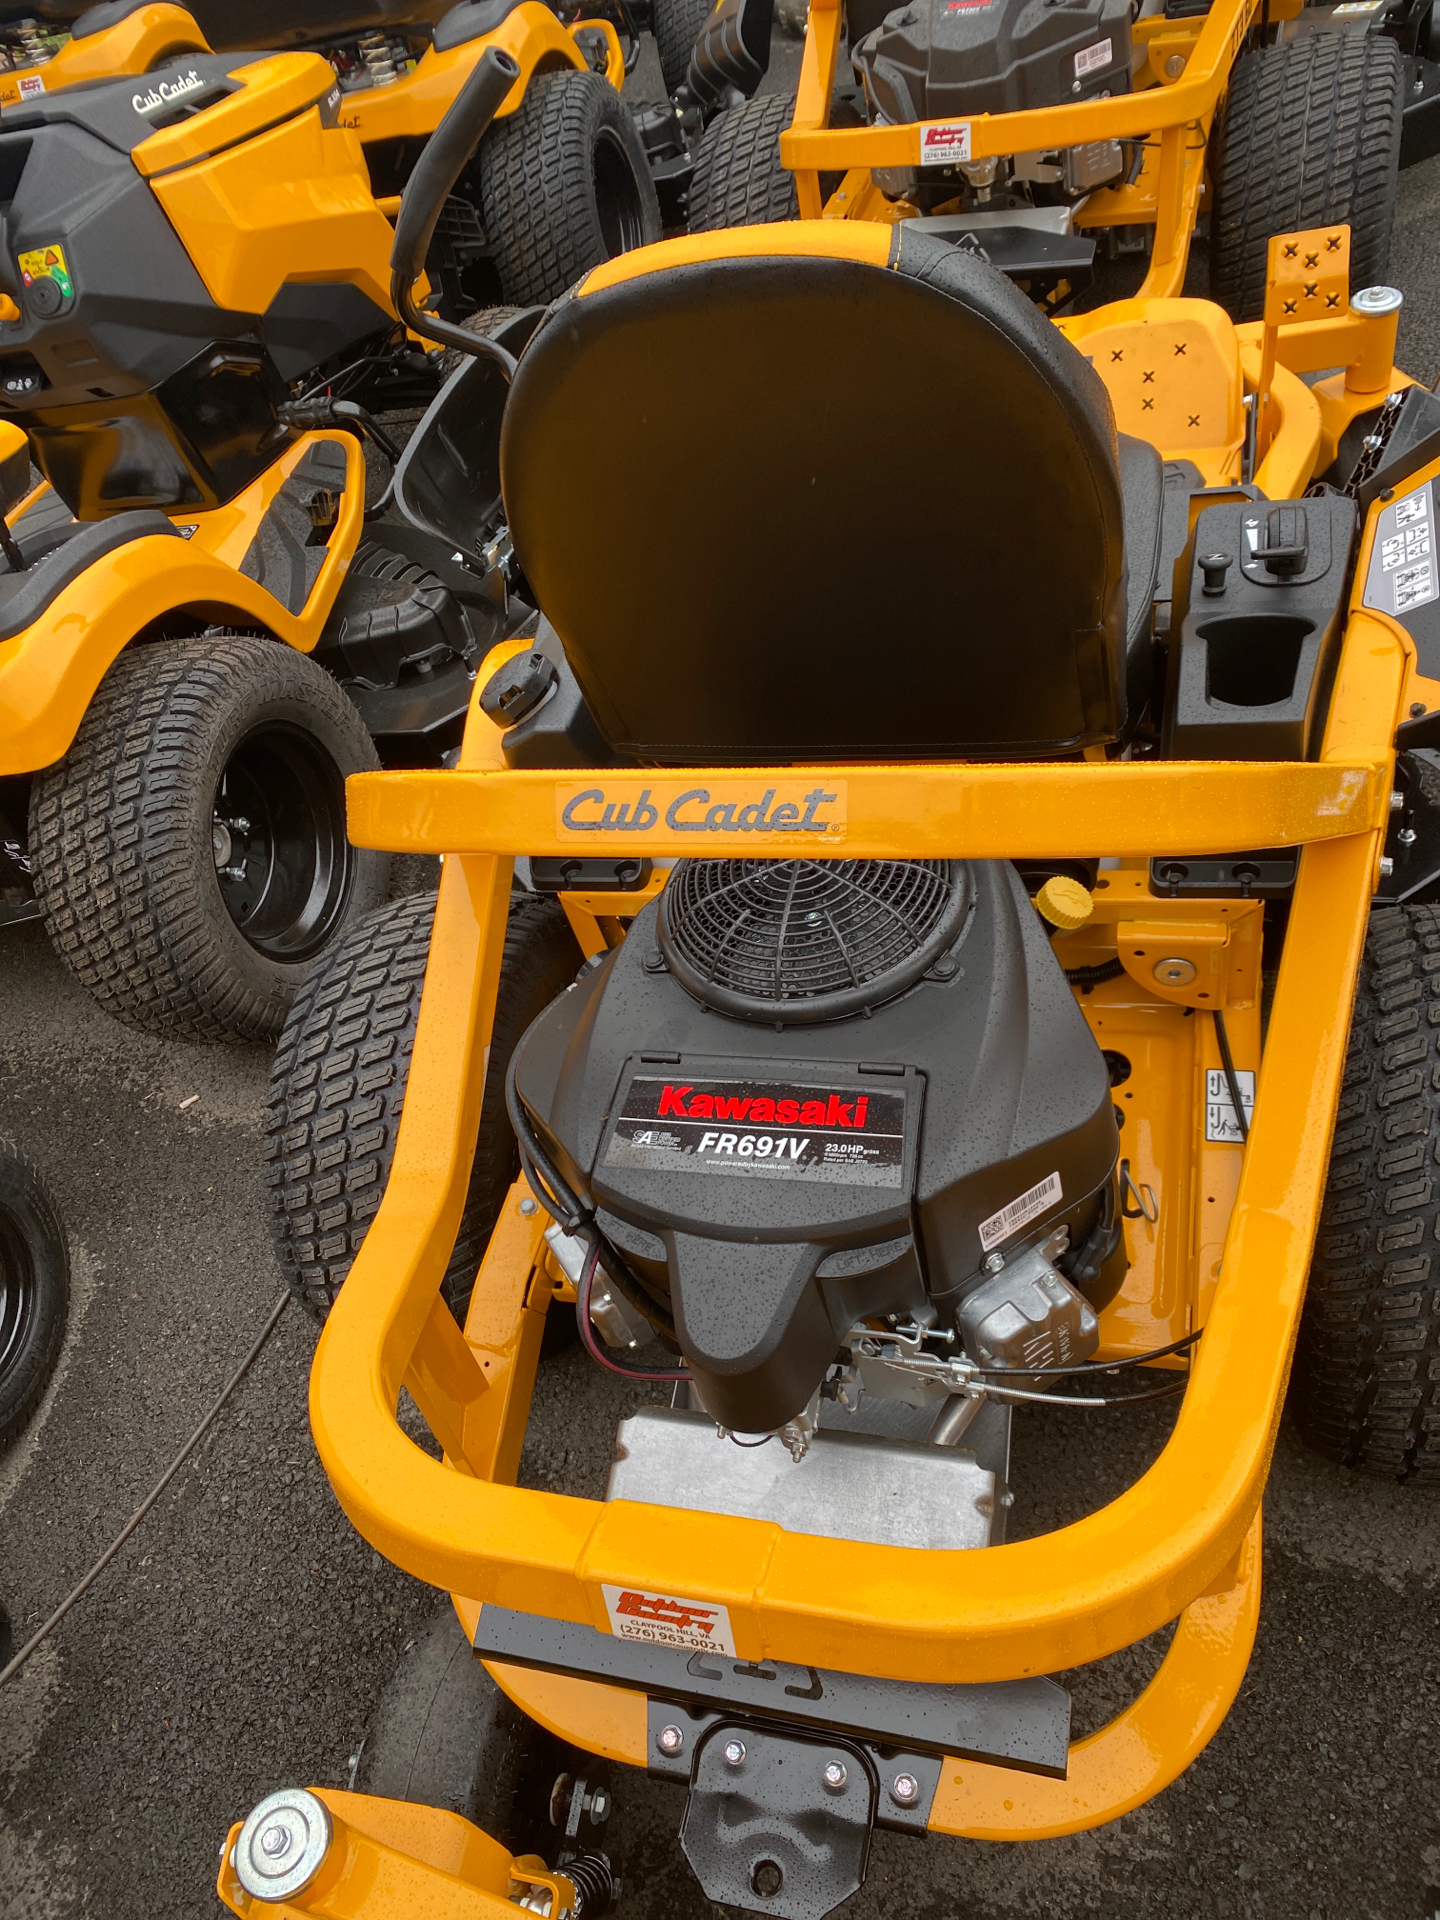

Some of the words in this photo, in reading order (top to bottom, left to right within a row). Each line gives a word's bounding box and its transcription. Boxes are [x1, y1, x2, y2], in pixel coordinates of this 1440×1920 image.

[132, 88, 163, 114] Cub
[158, 70, 205, 101] Cadet
[258, 679, 351, 734] MASTER
[562, 788, 659, 831] Cub
[665, 788, 838, 832] Cadet
[657, 1085, 869, 1128] Kawasaki
[632, 1129, 660, 1146] SAE
[697, 1131, 811, 1159] FR691V
[706, 1160, 790, 1170] www.poweredbykawasaki.com
[836, 1251, 862, 1270] LIFT
[870, 1241, 901, 1262] HERE
[616, 1601, 715, 1634] Country
[618, 1591, 719, 1618] Outdoor
[620, 1624, 656, 1639] (276)
[658, 1632, 725, 1652] 963-0021
[630, 1619, 675, 1633] CLAYPOOL
[676, 1628, 698, 1637] HILL,
[698, 1632, 711, 1640] VA
